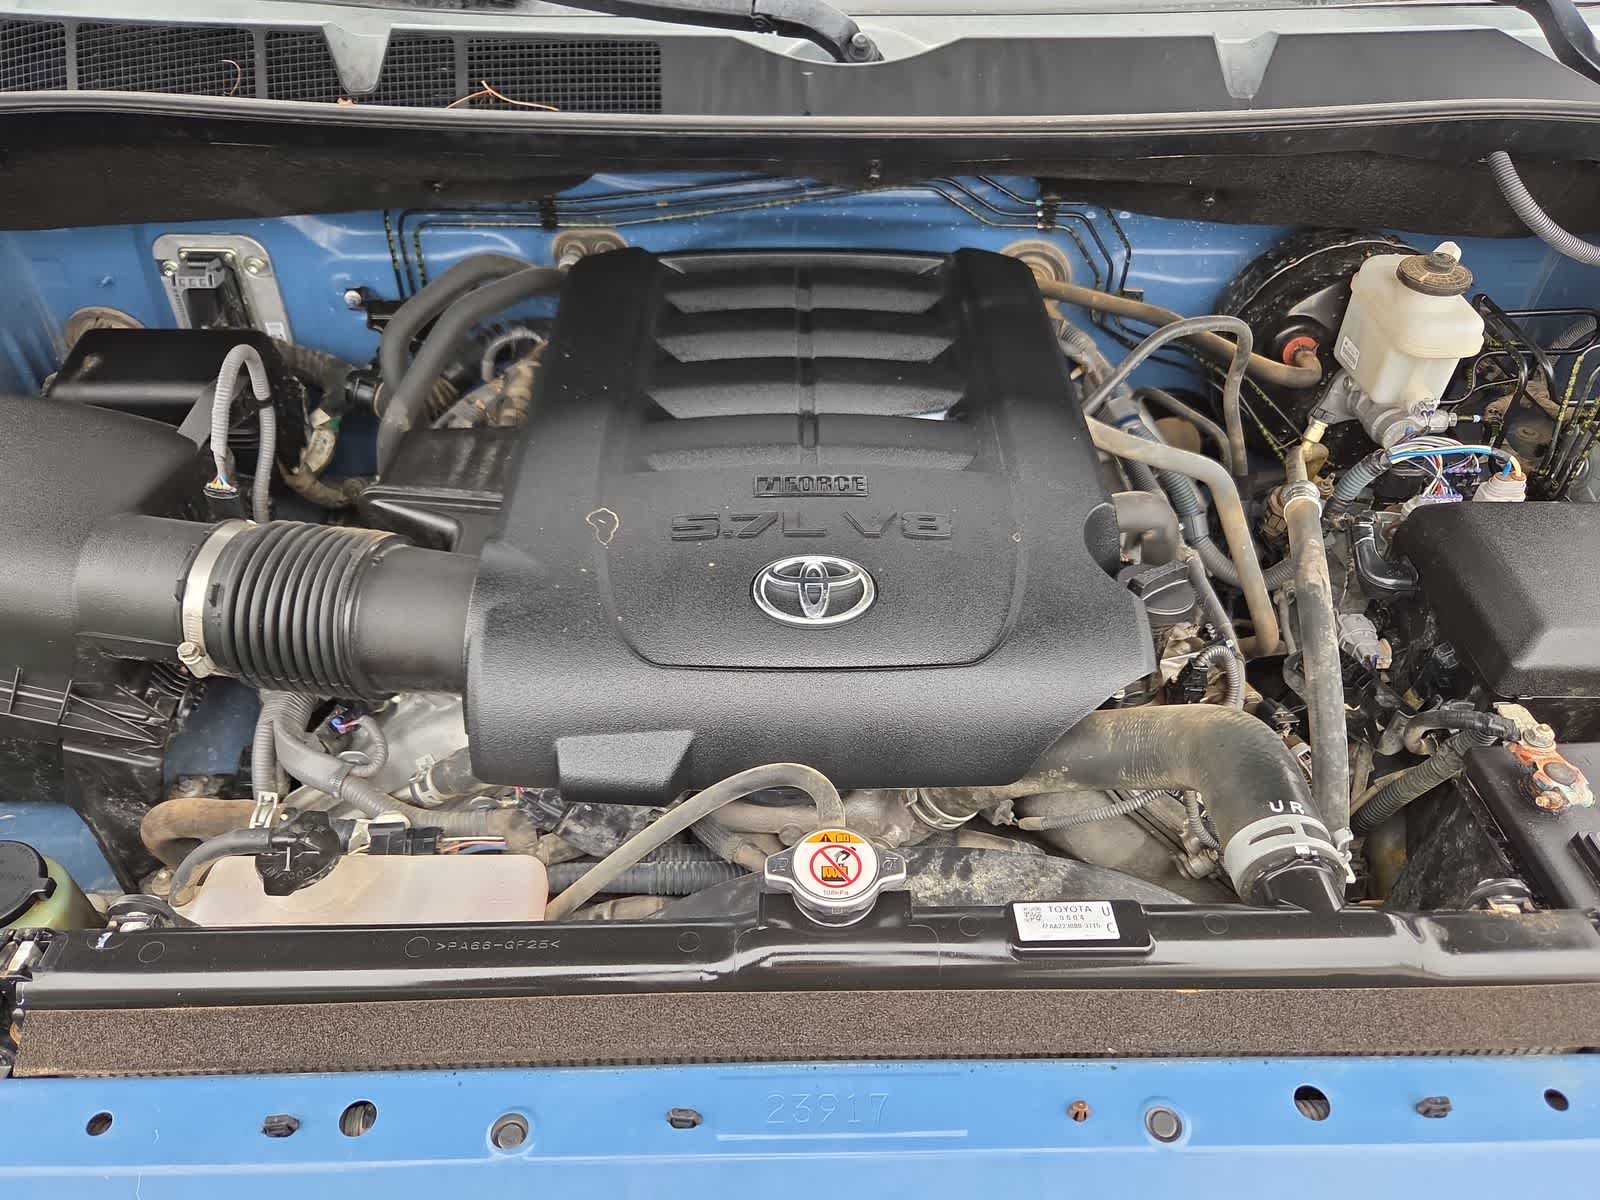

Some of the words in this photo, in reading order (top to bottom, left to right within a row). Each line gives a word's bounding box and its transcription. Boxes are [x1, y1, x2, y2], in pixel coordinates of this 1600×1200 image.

[842, 511, 951, 541] V8
[1048, 905, 1093, 913] TOYOTA
[1100, 905, 1111, 917] U
[767, 1092, 889, 1125] 23917
